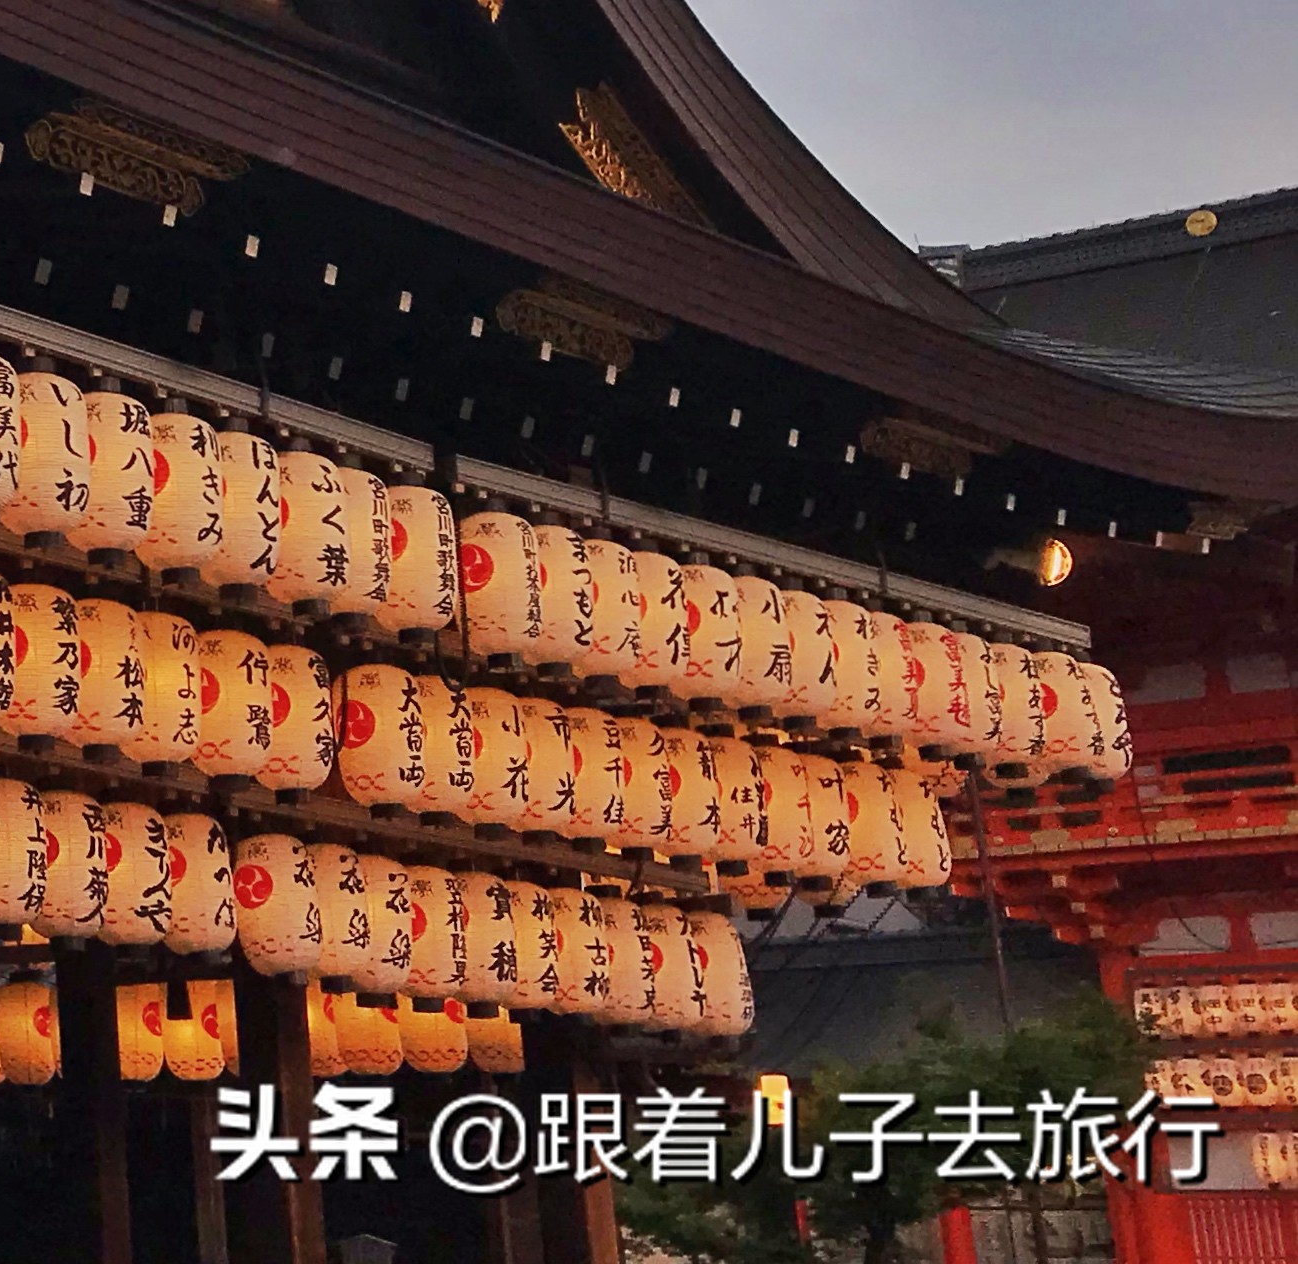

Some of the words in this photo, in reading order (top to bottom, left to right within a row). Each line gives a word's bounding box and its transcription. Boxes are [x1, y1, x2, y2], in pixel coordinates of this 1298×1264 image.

[50, 382, 90, 513] いし初
[119, 402, 154, 532] 堀八重
[311, 464, 349, 586] ふく葉
[567, 535, 595, 647] まつもと
[114, 654, 146, 729] 松本
[502, 704, 530, 803] 小花
